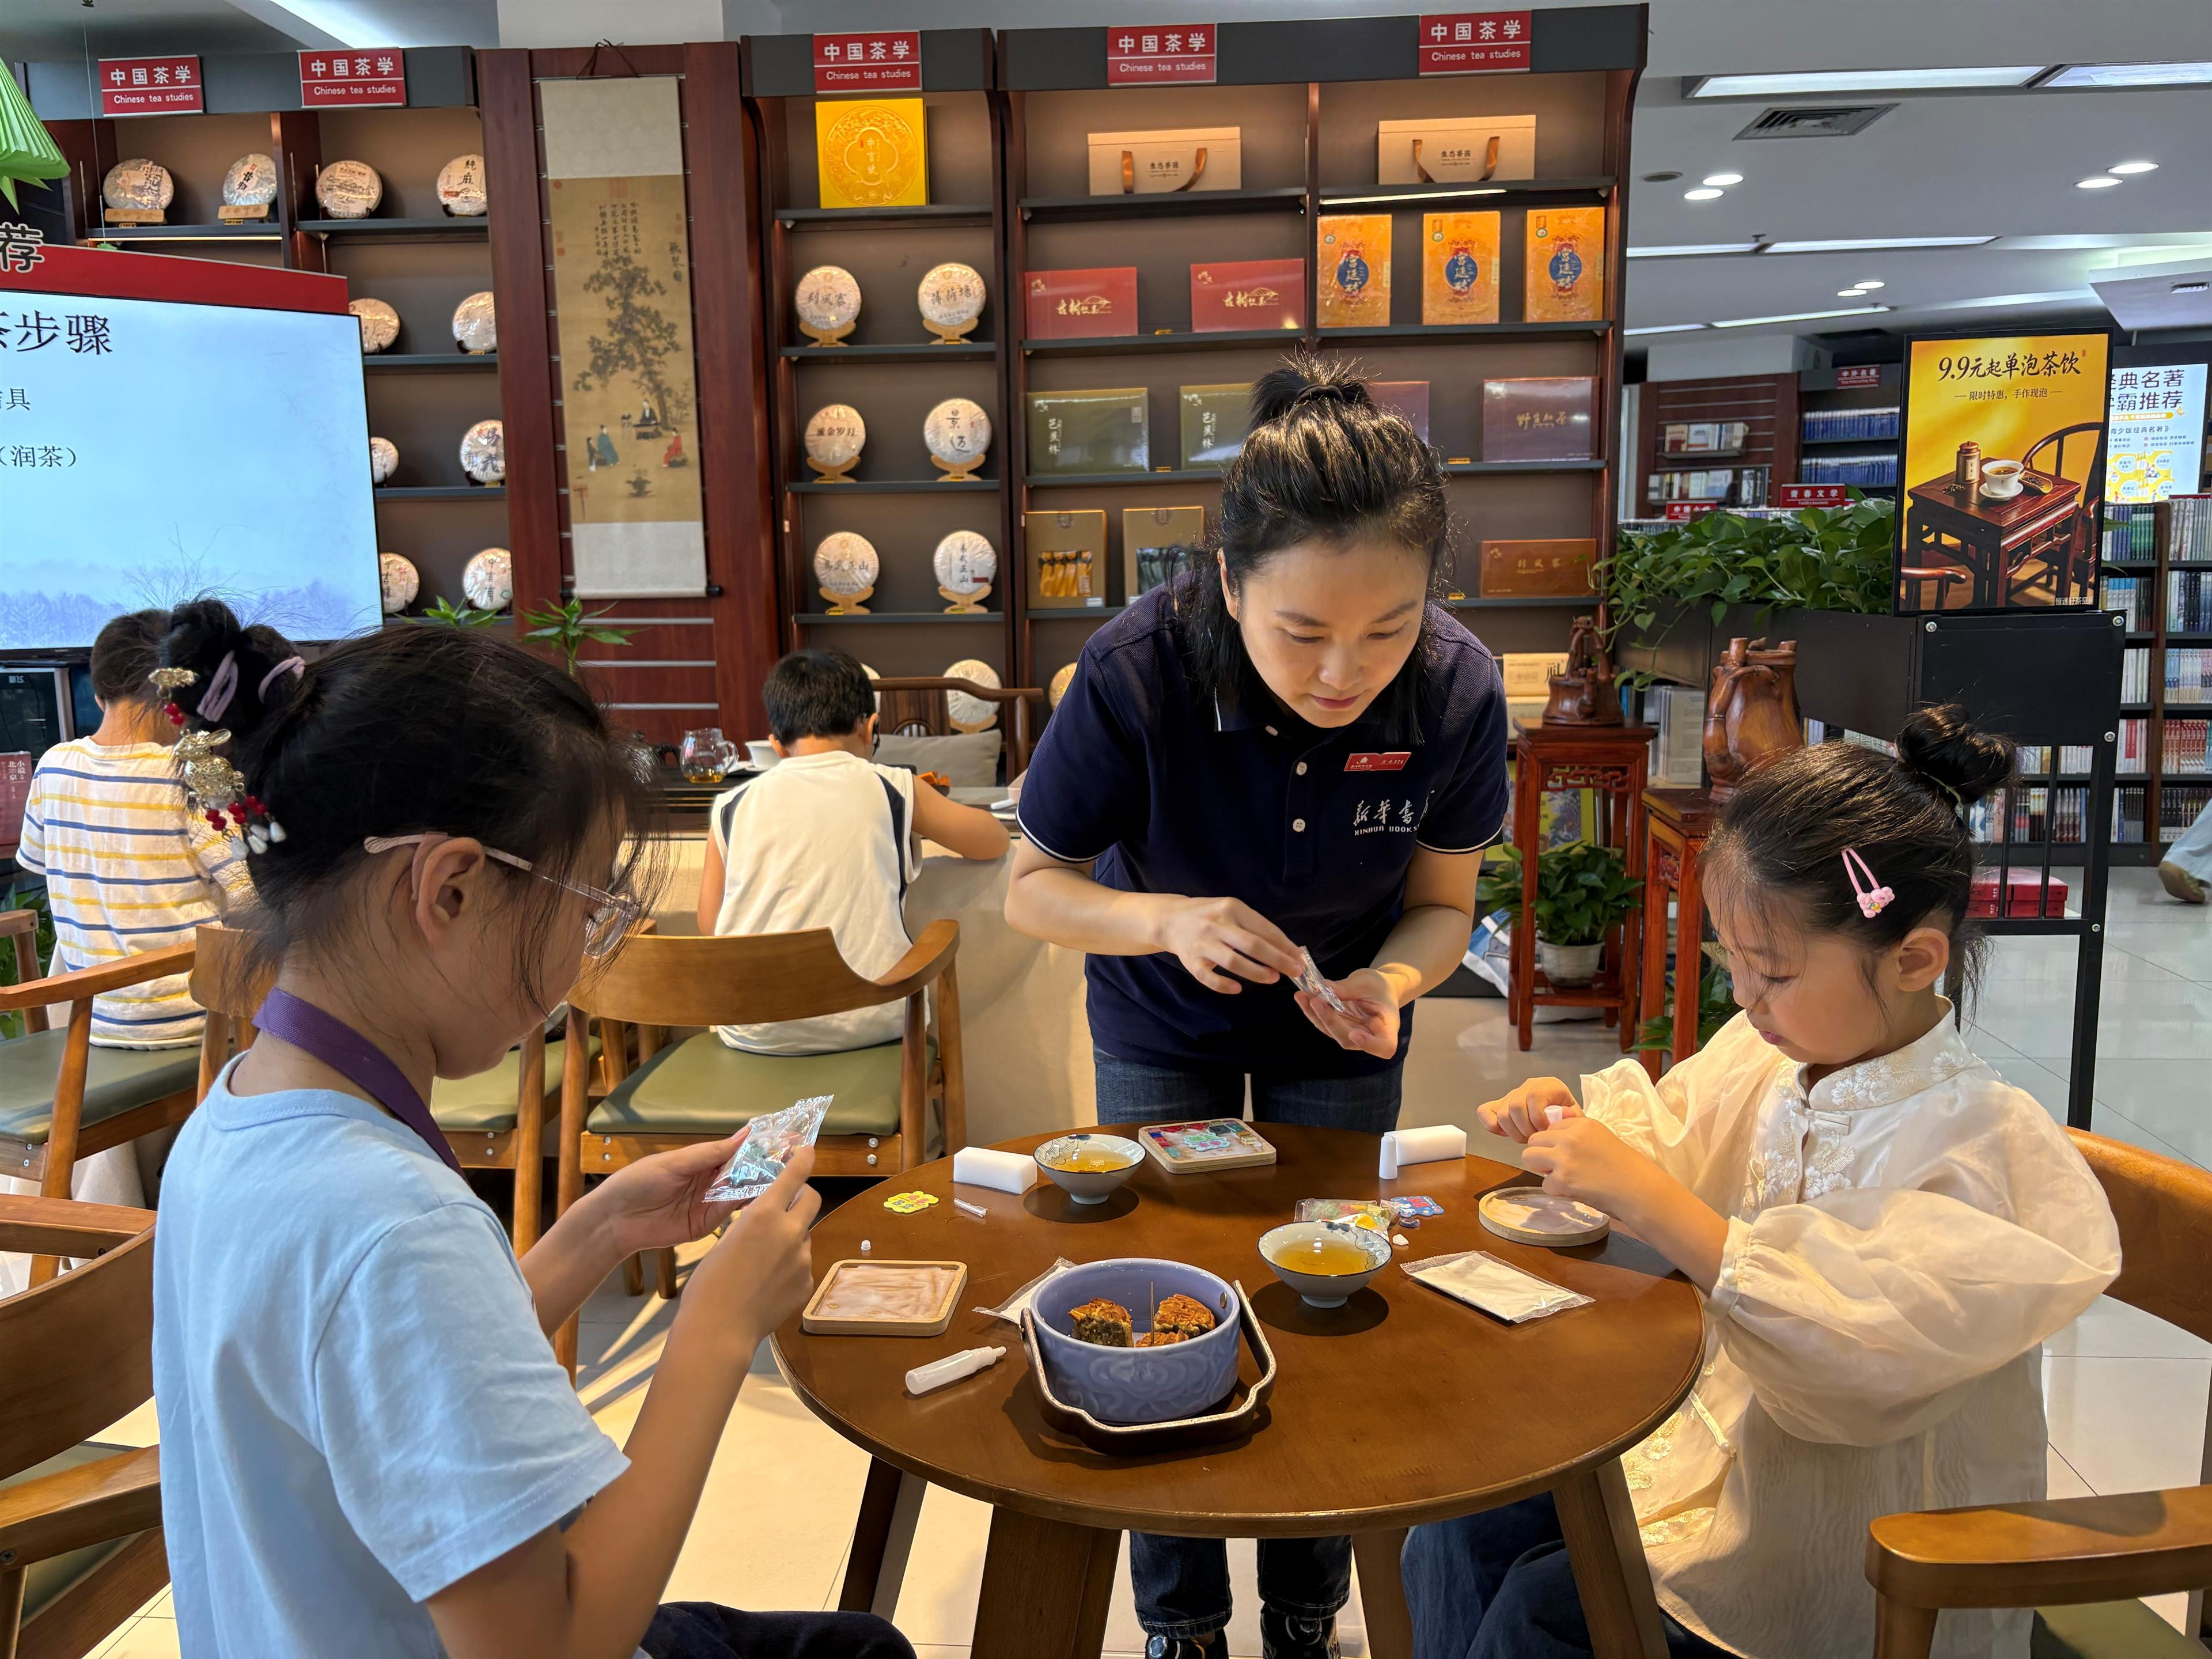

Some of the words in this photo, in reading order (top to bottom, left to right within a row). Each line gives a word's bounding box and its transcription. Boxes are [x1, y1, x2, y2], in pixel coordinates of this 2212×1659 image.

[1431, 20, 1521, 42] 中国茶学
[824, 41, 909, 61] 中国茶学
[1118, 33, 1206, 54] 中国茶学
[1431, 51, 1465, 61] Chinese
[1471, 51, 1485, 59] tea
[1489, 49, 1521, 58] studies
[111, 65, 191, 86] 中国茶学
[311, 56, 393, 77] 中国茶学
[826, 70, 859, 80] Chinese
[863, 70, 877, 79] tea
[881, 69, 911, 78] studies
[1119, 63, 1153, 72] Chinese
[1158, 63, 1172, 71] tea
[1176, 61, 1206, 71] studies
[114, 94, 145, 104] Chinese
[165, 93, 194, 101] studies
[314, 86, 346, 95] Chinese
[367, 84, 396, 93] studies
[0, 224, 43, 272] 荐
[0, 309, 113, 356] 步骤
[1937, 350, 2082, 381] 9.9元起单泡茶饮
[0, 387, 31, 411] 具
[1969, 387, 2048, 402] 限时特惠，手作现泡
